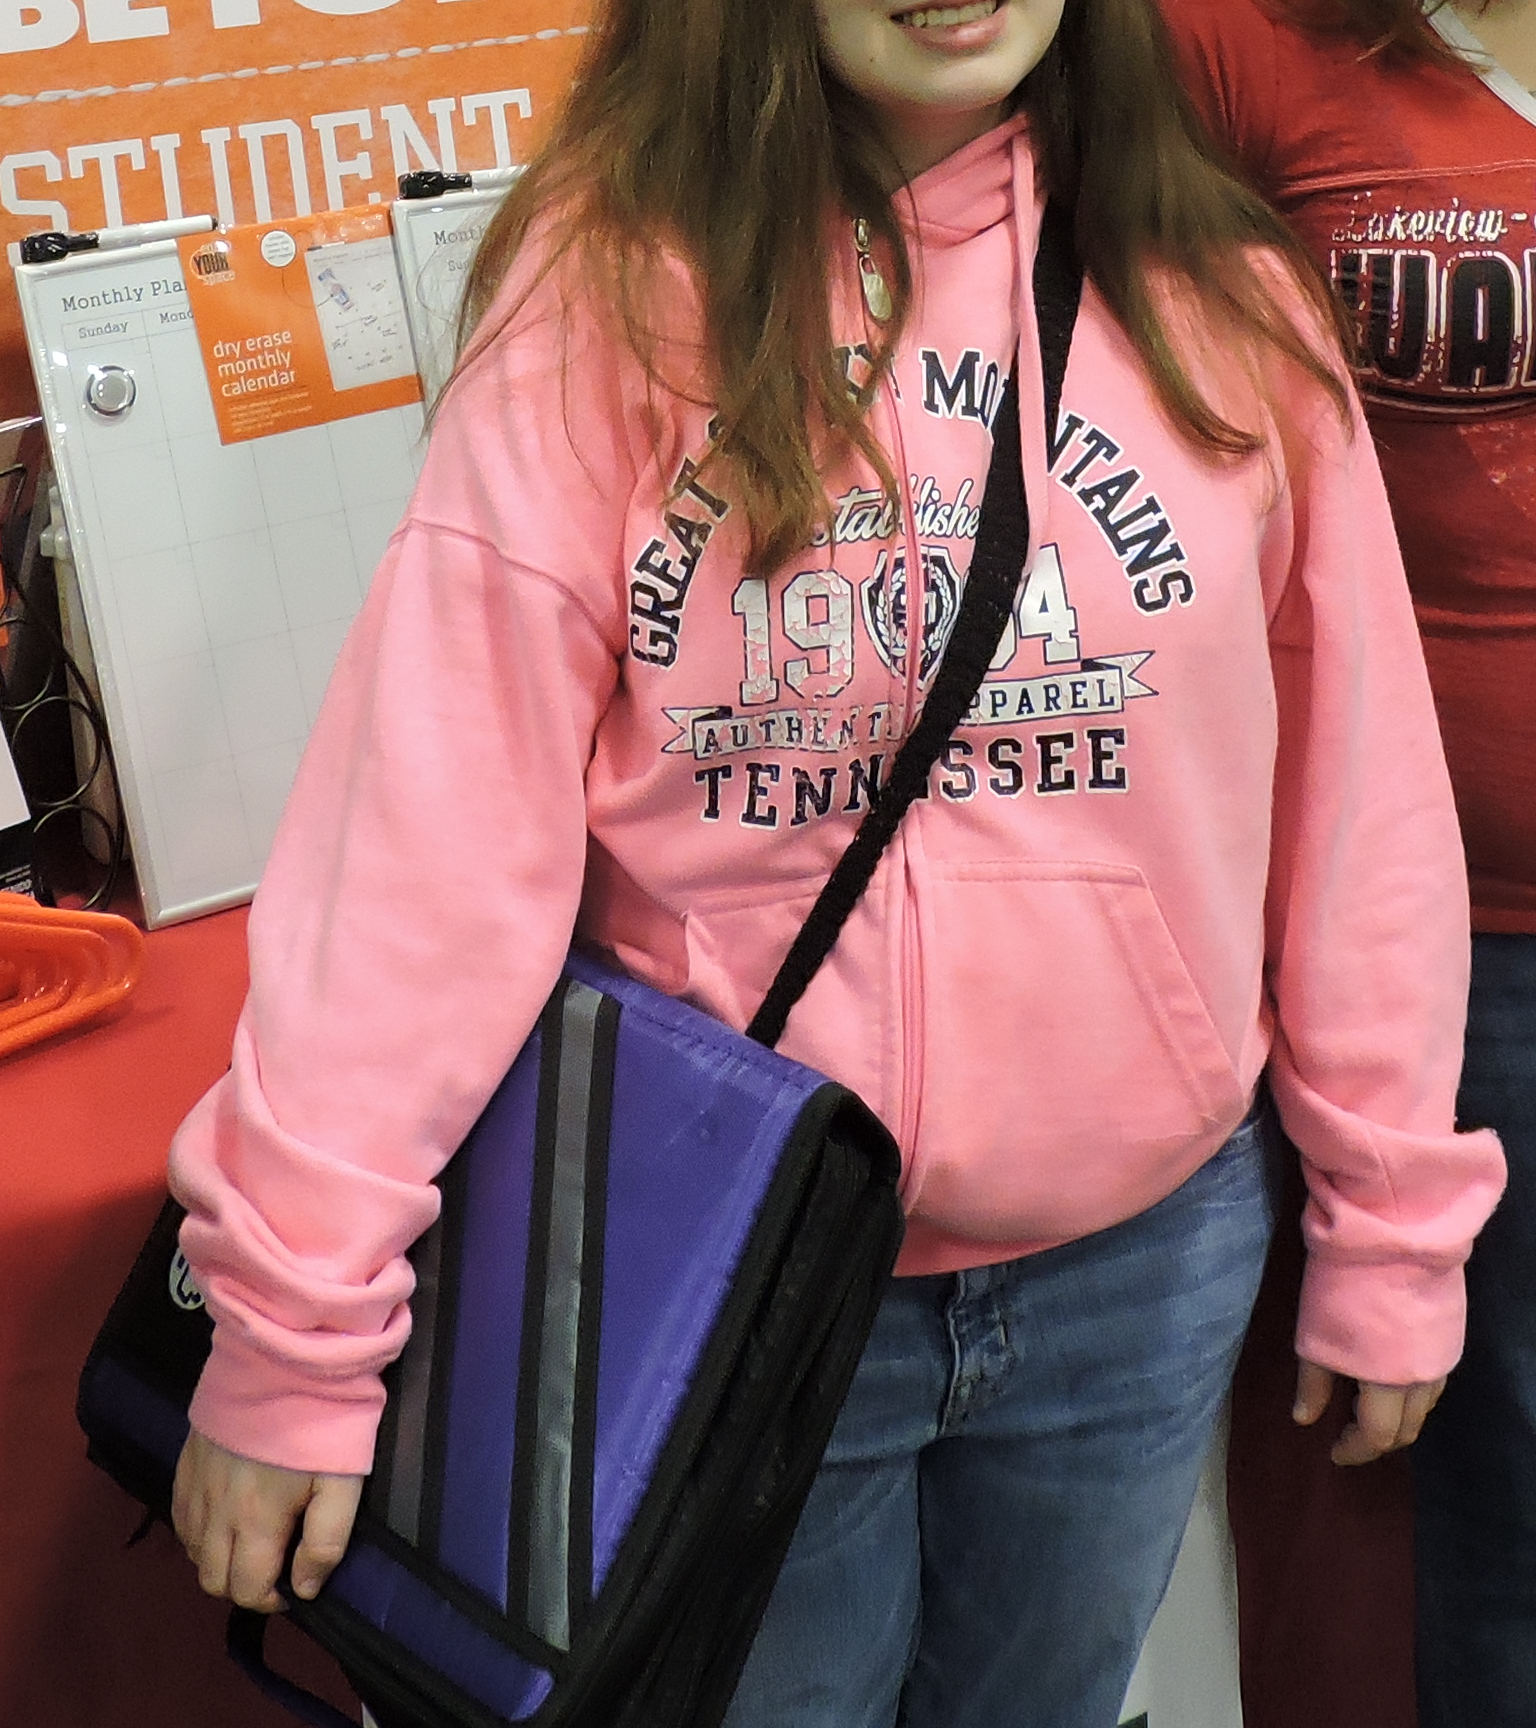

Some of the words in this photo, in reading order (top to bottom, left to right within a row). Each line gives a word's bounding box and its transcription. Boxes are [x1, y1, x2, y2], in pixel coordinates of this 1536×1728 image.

[62, 286, 143, 312] Monthly
[150, 279, 187, 296] Pla
[79, 322, 128, 339] Sunday
[213, 340, 241, 358] dry
[246, 331, 292, 351] erase
[218, 349, 291, 378] monthly
[222, 370, 295, 397] calendar
[628, 455, 731, 669] GREAT
[695, 726, 1127, 829] TENNSSEE
